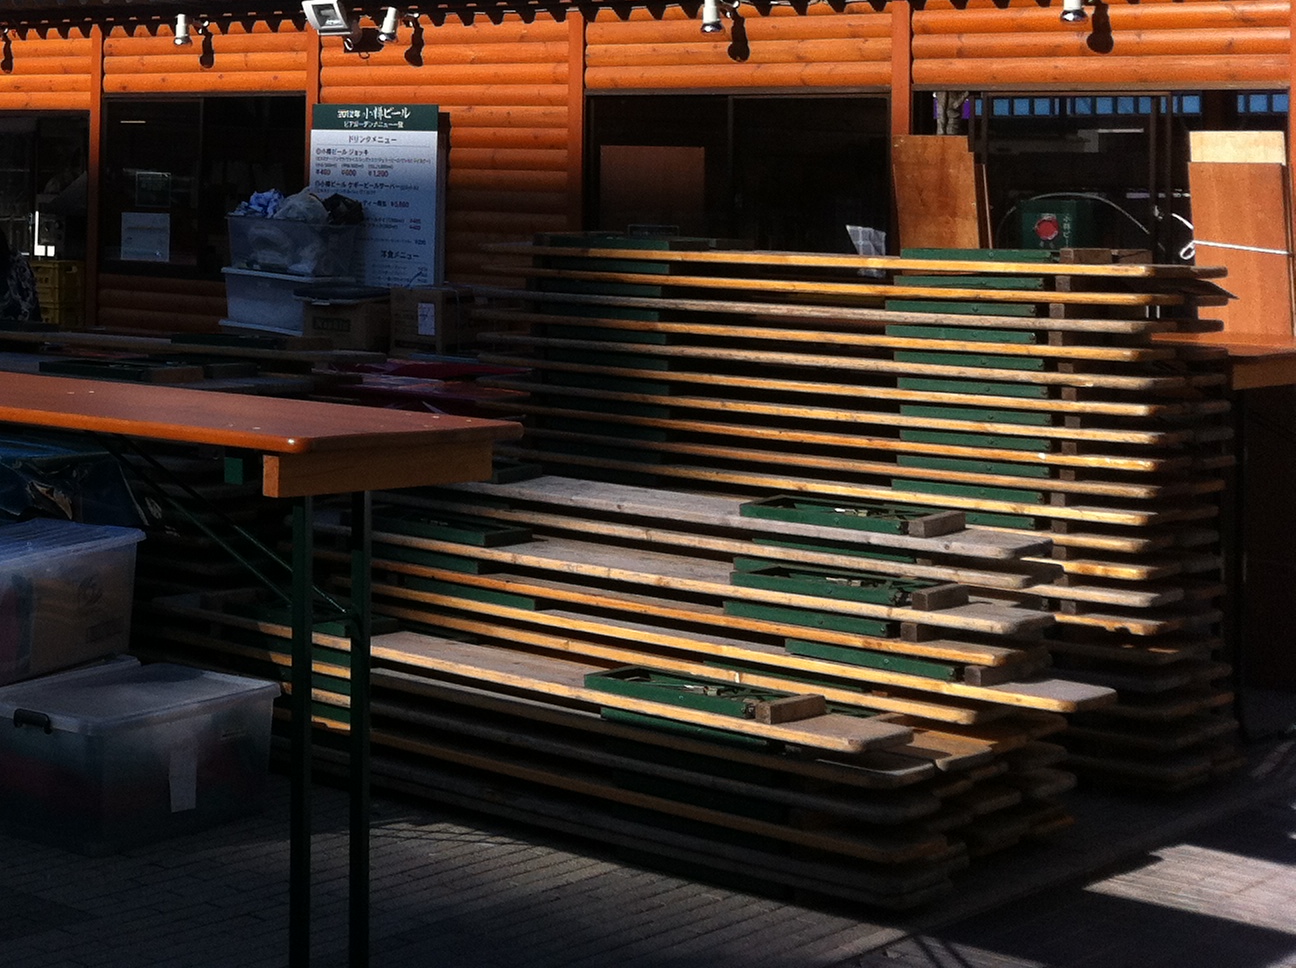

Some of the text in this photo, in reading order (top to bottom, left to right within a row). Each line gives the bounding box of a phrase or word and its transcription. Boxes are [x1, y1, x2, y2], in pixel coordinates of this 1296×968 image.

[363, 106, 411, 121] 小樽ビール
